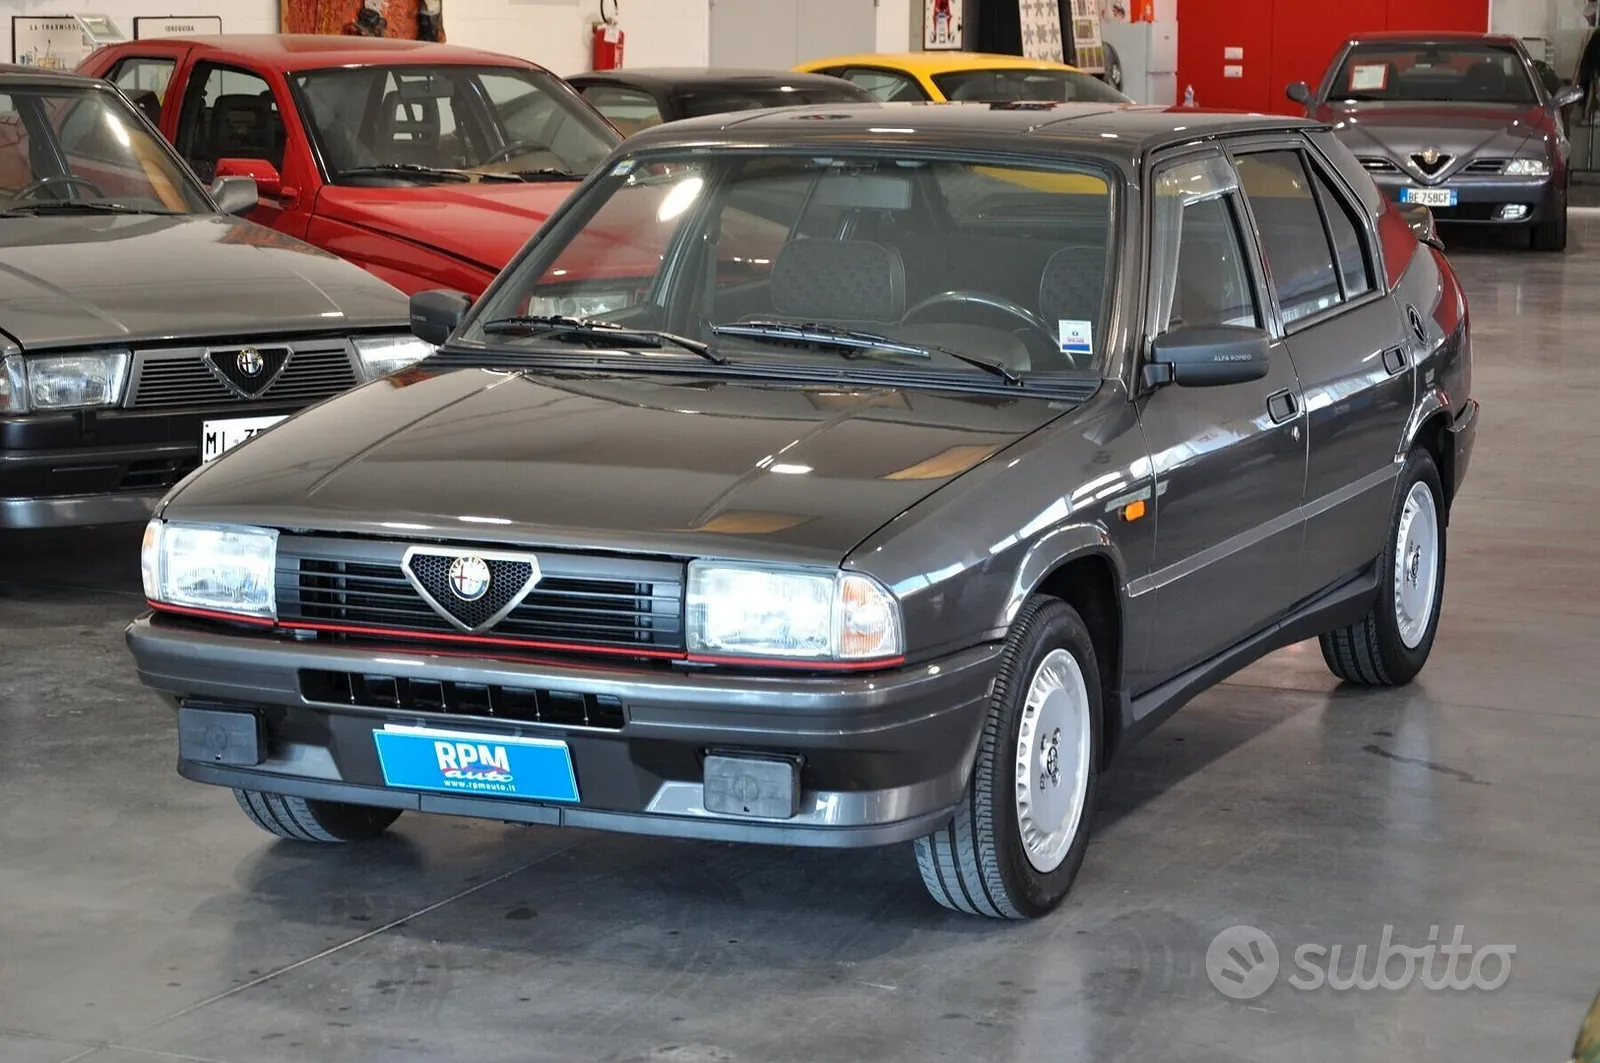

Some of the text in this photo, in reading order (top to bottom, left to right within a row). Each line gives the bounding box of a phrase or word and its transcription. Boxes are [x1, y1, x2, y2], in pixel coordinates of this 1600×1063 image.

[206, 431, 225, 454] MI
[434, 741, 510, 772] RPM
[445, 770, 513, 782] auto
[444, 780, 516, 792] www.rpmauto.it
